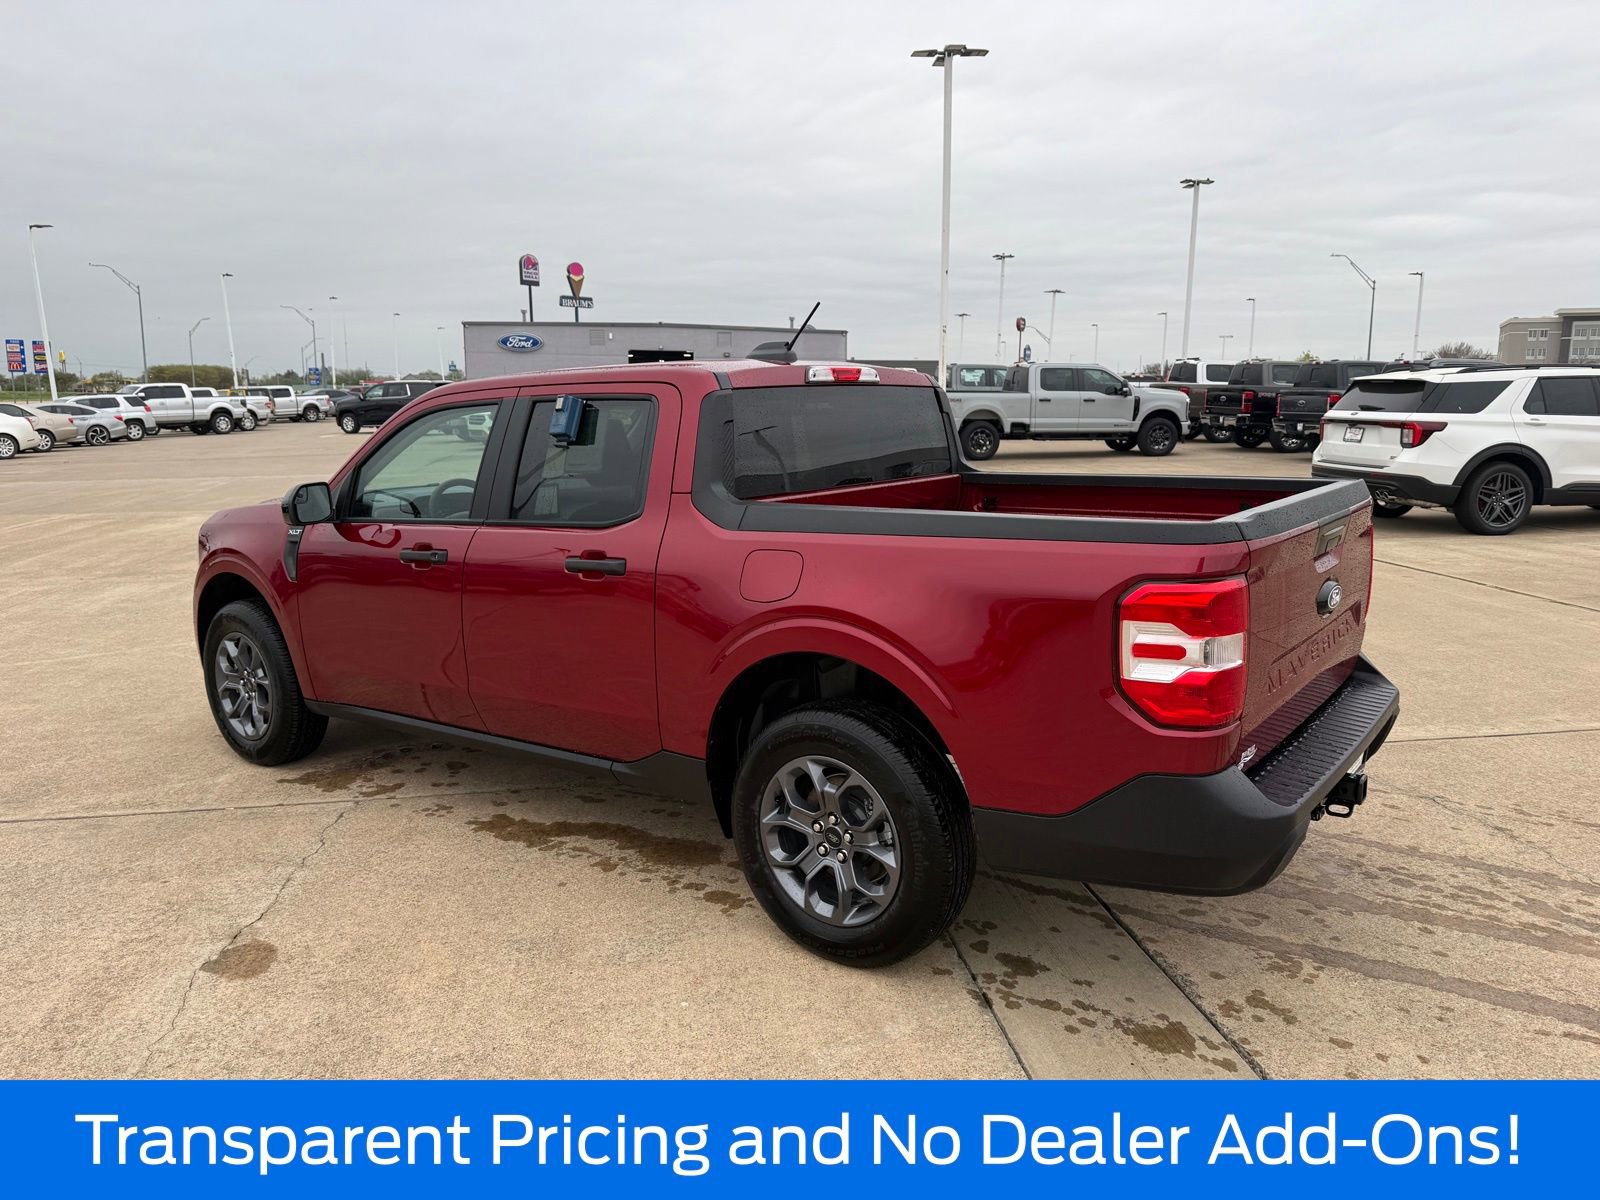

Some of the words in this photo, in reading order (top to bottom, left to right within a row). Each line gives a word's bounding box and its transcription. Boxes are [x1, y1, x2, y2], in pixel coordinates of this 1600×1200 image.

[562, 298, 594, 308] BRAUM'S
[506, 335, 533, 348] Ford
[1266, 618, 1353, 696] MAVERICK
